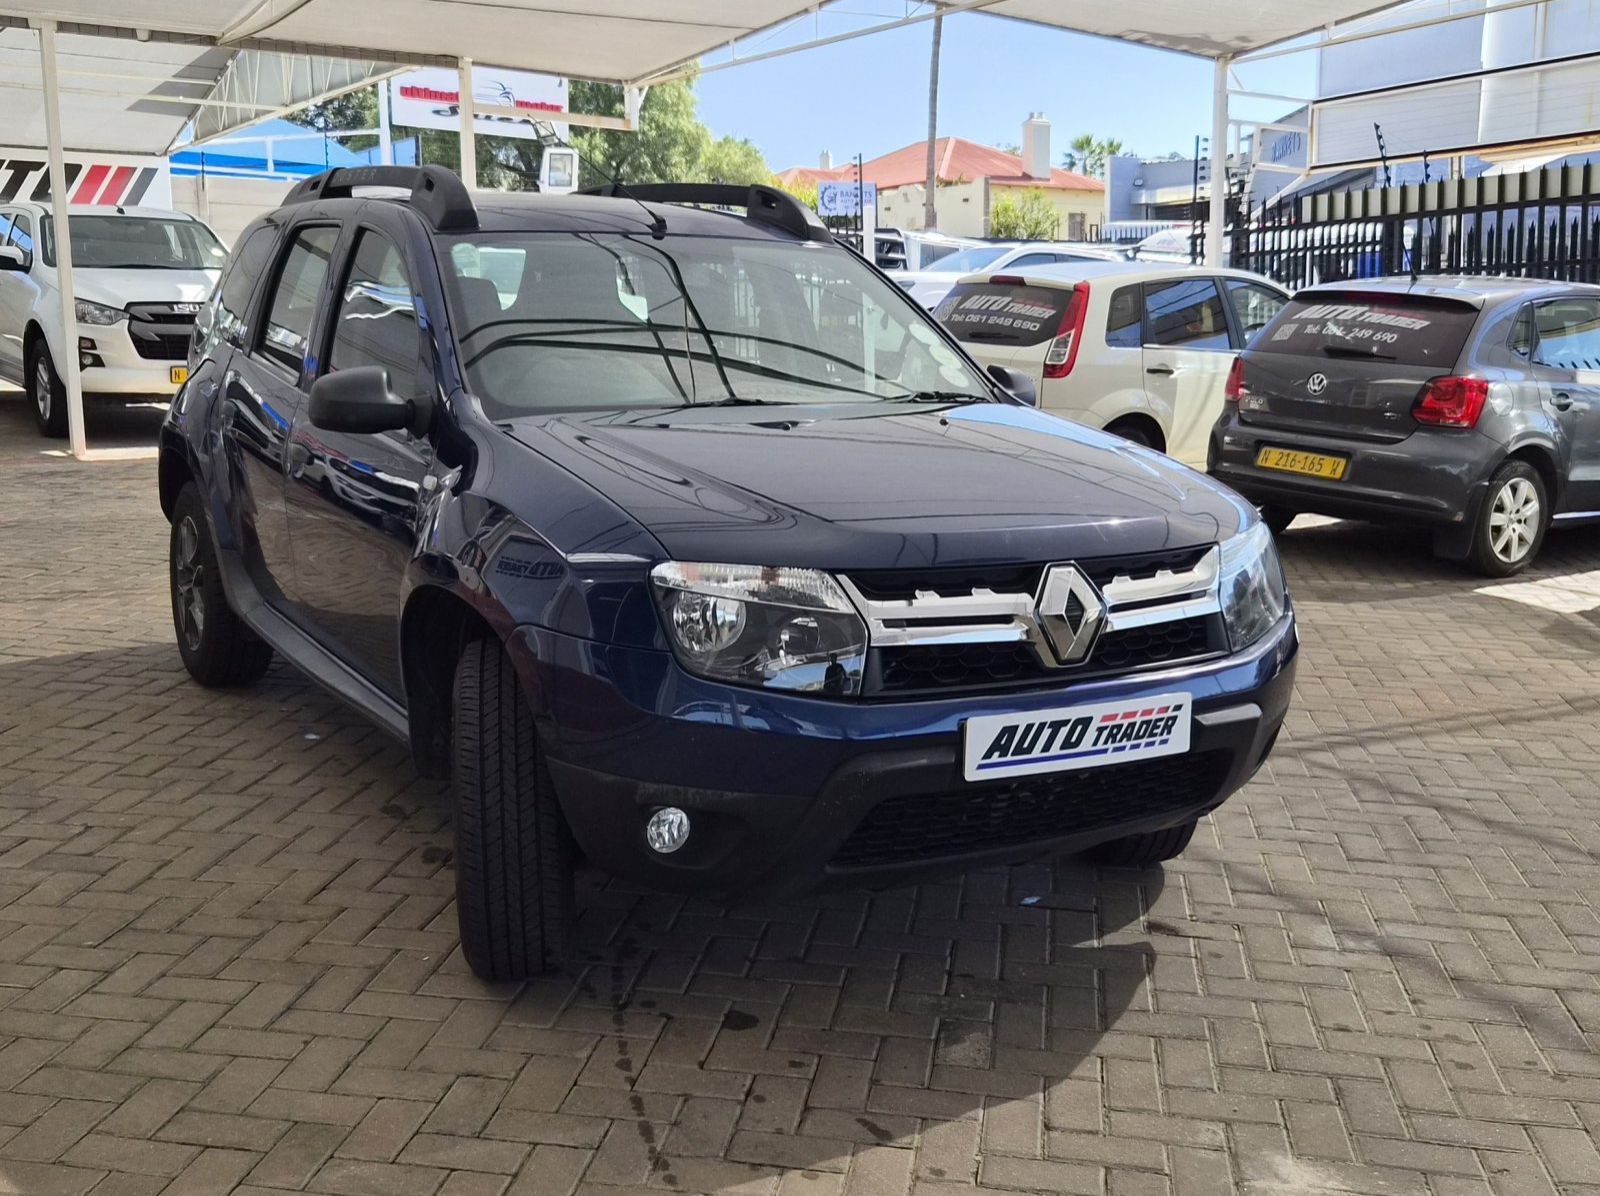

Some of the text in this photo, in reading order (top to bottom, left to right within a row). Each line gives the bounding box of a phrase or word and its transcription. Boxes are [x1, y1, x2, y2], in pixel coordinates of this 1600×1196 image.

[960, 295, 1057, 319] AUTO TRADER
[1292, 305, 1431, 330] AUTO TRADER
[965, 314, 986, 324] 061
[988, 315, 1013, 328] 249
[1013, 319, 1040, 331] 690
[1304, 324, 1320, 335] Tel:
[1349, 327, 1373, 339] 249
[1372, 331, 1397, 344] 690
[1261, 450, 1341, 475] N 216-165 W
[981, 715, 1178, 760] AUTO TRADER
